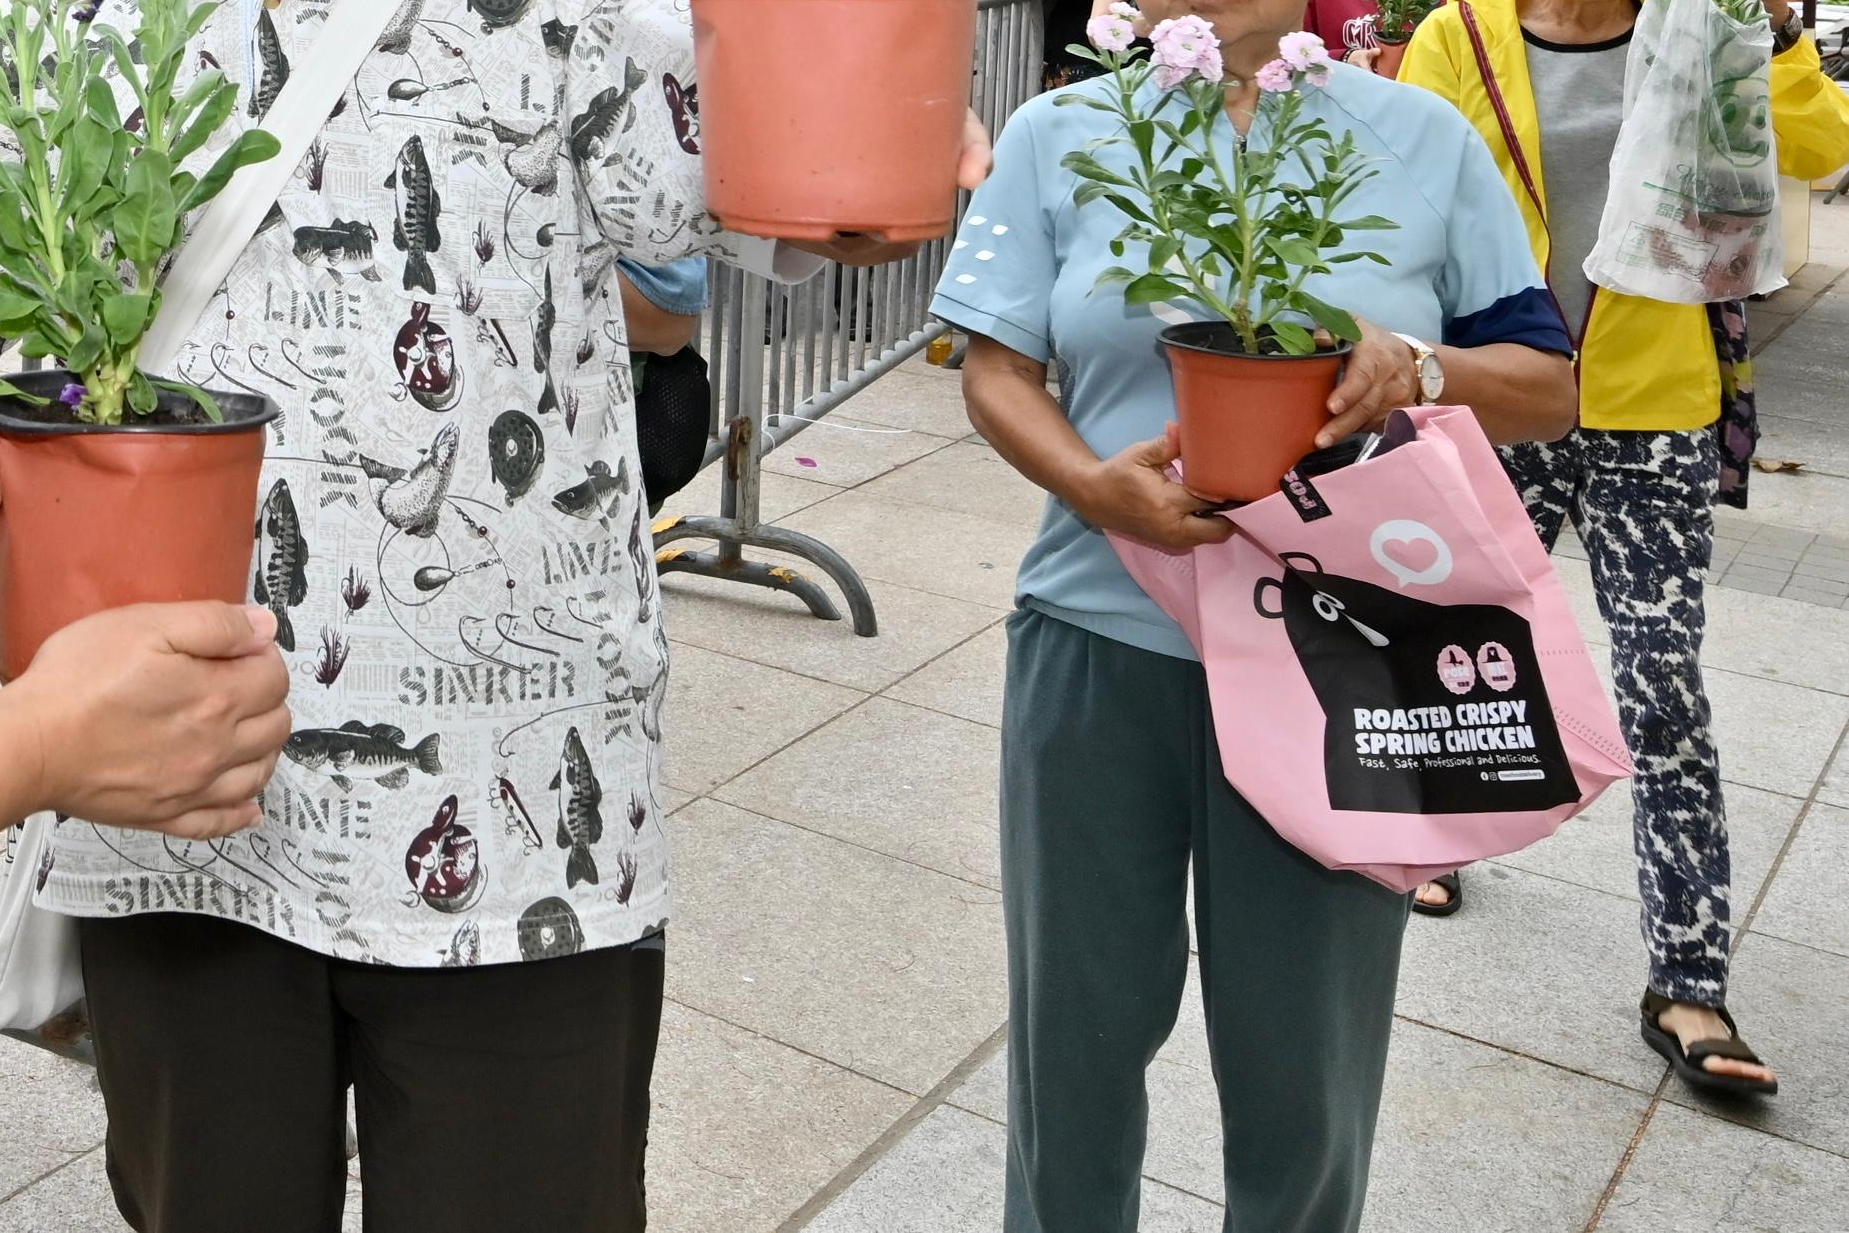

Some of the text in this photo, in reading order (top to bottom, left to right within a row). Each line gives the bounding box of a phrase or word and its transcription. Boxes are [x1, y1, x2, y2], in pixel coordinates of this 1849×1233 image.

[264, 280, 363, 331] LINE
[398, 661, 576, 706] SINKER
[1354, 699, 1527, 731] ROASTED CRISPY
[1354, 725, 1536, 755] SPRING CHICKEN
[1423, 755, 1475, 768] Professional
[1477, 754, 1494, 766] and
[104, 873, 297, 937] SINKER
